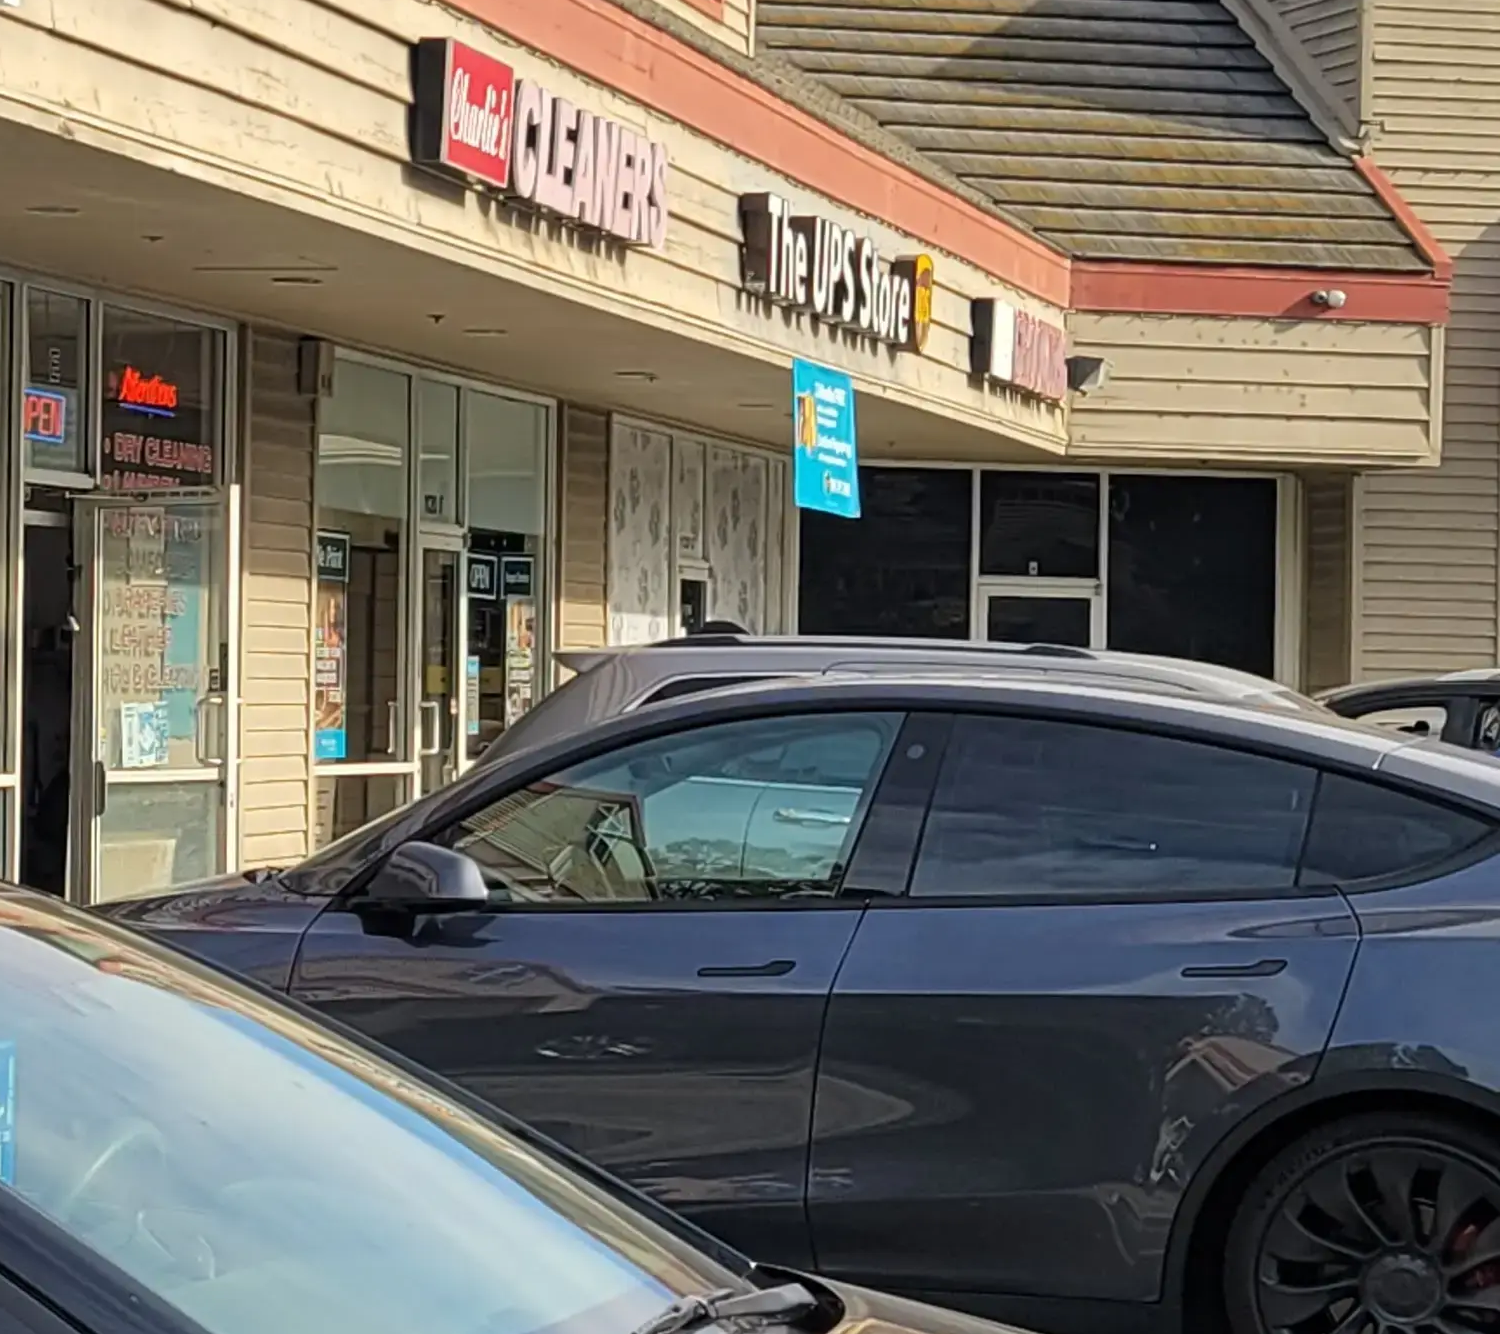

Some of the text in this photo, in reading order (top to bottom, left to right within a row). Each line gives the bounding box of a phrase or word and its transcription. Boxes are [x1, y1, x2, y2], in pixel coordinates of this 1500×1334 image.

[450, 67, 509, 160] Charlie's
[514, 78, 668, 250] CLEANERS
[767, 191, 911, 344] The UPS Store
[24, 393, 62, 437] PEN
